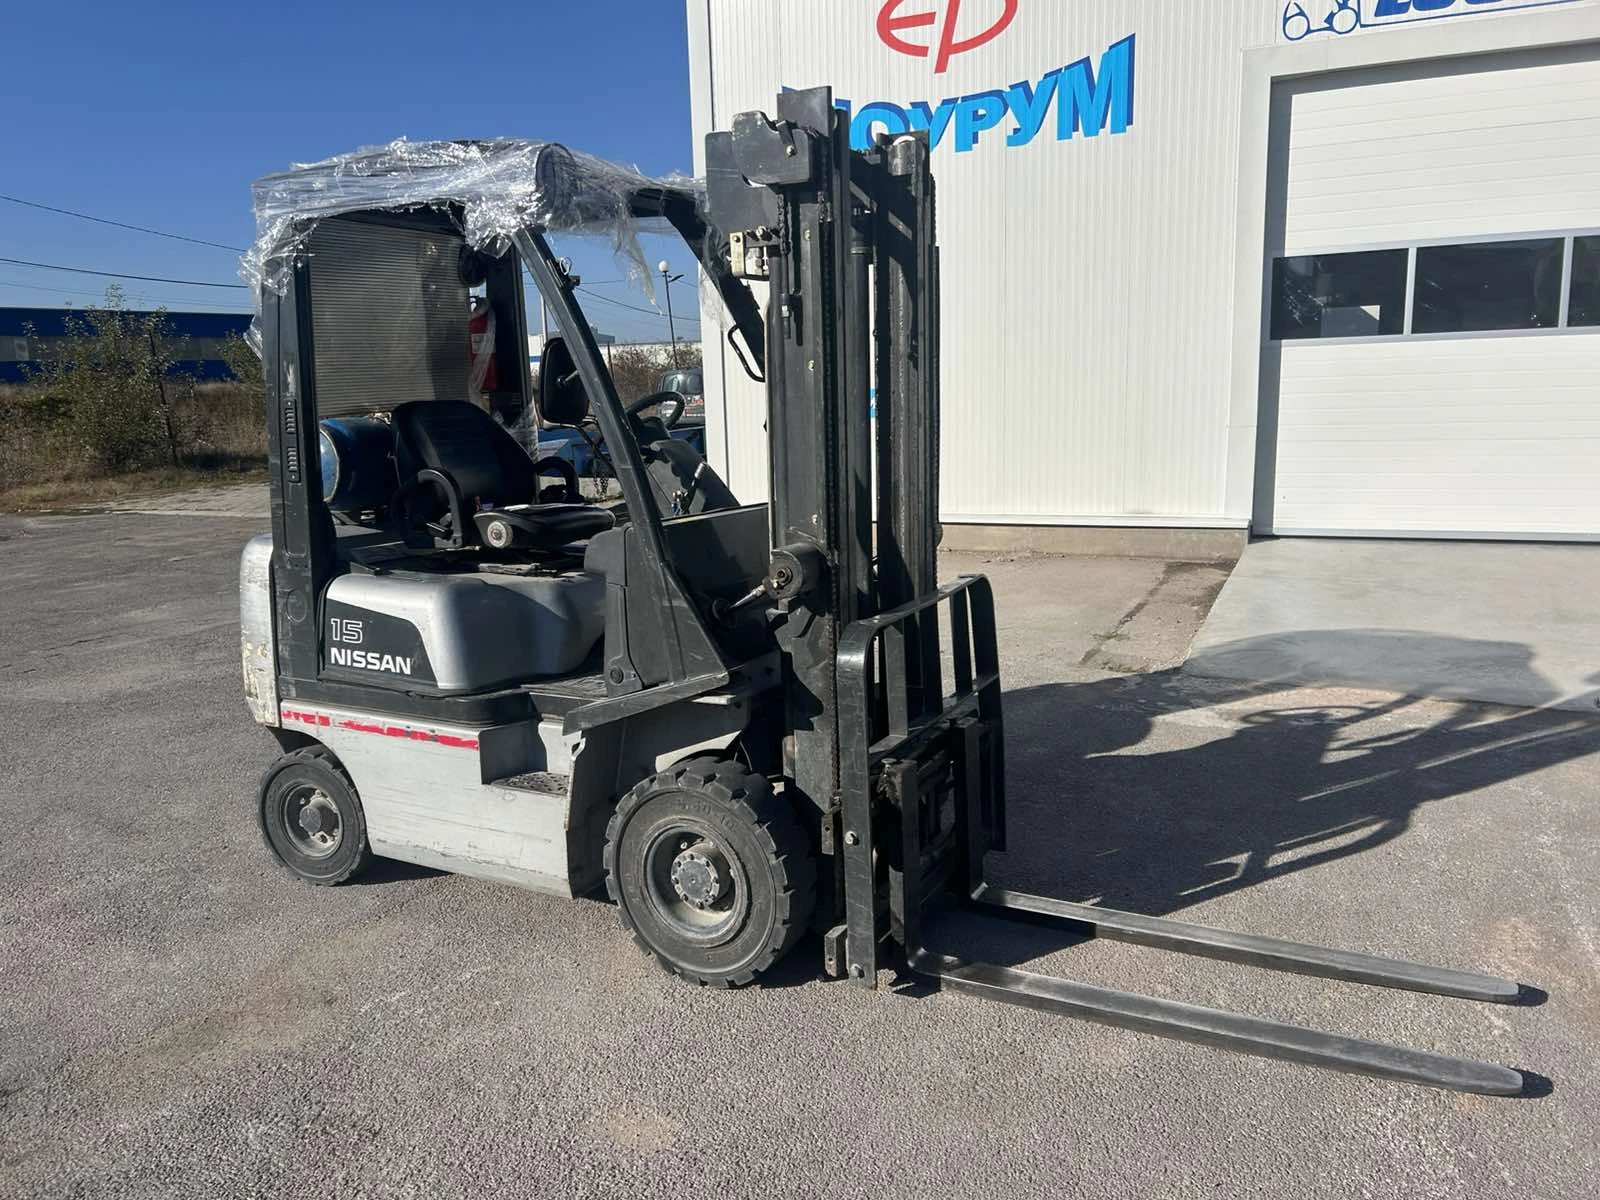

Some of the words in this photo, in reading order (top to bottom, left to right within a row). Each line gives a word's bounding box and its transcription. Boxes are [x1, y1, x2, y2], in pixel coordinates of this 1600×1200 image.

[782, 33, 1135, 153] ОУРУМ
[331, 618, 362, 643] 15
[330, 647, 411, 675] NISSAN
